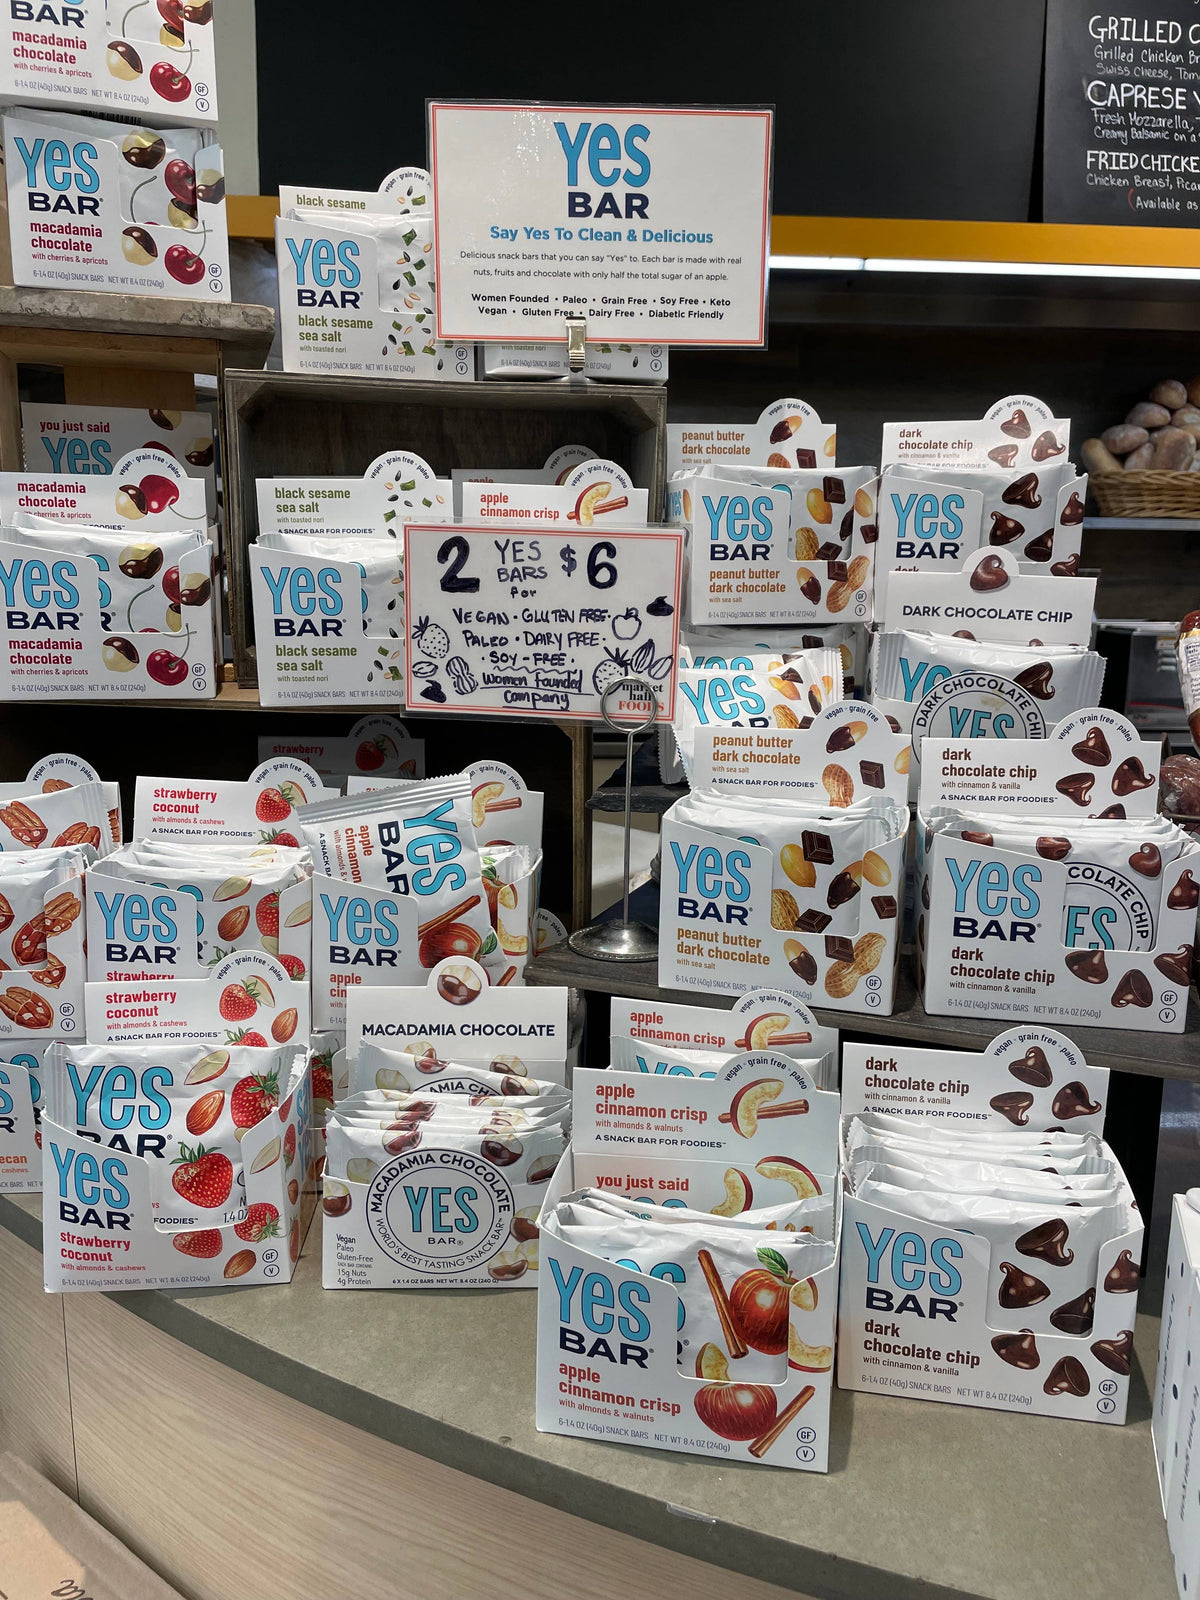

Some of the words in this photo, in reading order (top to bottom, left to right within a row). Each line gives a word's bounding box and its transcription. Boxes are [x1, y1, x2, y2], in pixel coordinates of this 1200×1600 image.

[1088, 15, 1182, 44] GRILLED
[1094, 45, 1134, 63] Grilled
[1140, 48, 1184, 64] Chicken
[1096, 63, 1131, 76] Swiss
[1087, 80, 1187, 110] CAPRESE
[1091, 107, 1125, 126] Fresh
[1093, 125, 1128, 145] Creamy
[1131, 128, 1170, 140] Balsamic
[1174, 133, 1187, 142] on
[554, 122, 651, 188] Yes
[1086, 150, 1139, 171] FRIED
[14, 137, 100, 194] Yes
[1086, 173, 1129, 187] Chicken
[568, 191, 650, 220] BAR
[1187, 201, 1199, 210] as
[30, 222, 103, 239] macadamia
[490, 225, 518, 242] Say
[523, 226, 550, 240] Yes
[554, 227, 573, 241] To
[578, 227, 622, 241] Clean
[626, 229, 637, 242] &
[642, 229, 714, 244] Delicious
[31, 237, 93, 253] chocolate
[32, 252, 46, 261] with
[48, 253, 74, 263] cherries
[75, 256, 81, 264] &
[82, 256, 108, 266] apricots
[285, 238, 361, 288] Yes
[460, 251, 495, 259] Delicious
[498, 252, 520, 260] snack
[522, 252, 539, 260] bars
[541, 252, 557, 261] that
[641, 255, 660, 263] Each
[685, 256, 707, 264] made
[709, 256, 726, 264] with
[727, 256, 742, 264] real
[473, 269, 493, 277] nuts,
[494, 268, 515, 277] fruits
[516, 269, 532, 277] and
[533, 269, 571, 278] chocolate
[573, 270, 590, 278] with
[592, 271, 609, 280] only
[611, 271, 625, 279] half
[641, 272, 660, 280] total
[661, 273, 682, 281] sugar
[684, 272, 692, 280] of
[705, 273, 729, 282] apple.
[471, 293, 506, 303] Women
[509, 294, 549, 303] Founded
[562, 295, 588, 304] Paleo
[601, 296, 625, 304] Grain
[627, 297, 648, 305] Free
[660, 296, 677, 306] Soy
[679, 297, 699, 305] Free
[709, 298, 731, 306] Keto
[478, 306, 507, 316] Vegan
[522, 308, 551, 317] Gluten
[554, 308, 574, 317] Free
[589, 309, 612, 318] Dairy
[615, 309, 635, 317] Free
[648, 309, 685, 318] Diabetic
[688, 310, 724, 320] Friendly
[298, 315, 328, 328] black
[331, 317, 374, 329] sesame
[299, 331, 320, 342] sea
[321, 330, 342, 343] salt
[40, 420, 60, 434] you
[62, 420, 84, 434] just
[87, 420, 111, 433] said
[899, 428, 922, 439] dark
[682, 430, 714, 443] peanut
[716, 430, 745, 442] butter
[682, 444, 703, 455] dark
[706, 444, 751, 456] chocolate
[898, 439, 950, 451] chocolate
[952, 440, 973, 452] chip
[17, 481, 87, 494] macadamia
[275, 487, 305, 499] black
[308, 489, 350, 499] sesame
[18, 496, 77, 508] chocolate
[480, 492, 508, 505] apple
[276, 503, 297, 513] sea
[299, 501, 320, 513] salt
[480, 506, 531, 519] cinnamon
[533, 507, 560, 520] crisp
[494, 538, 542, 564] YES
[436, 534, 481, 594] 2
[496, 567, 549, 583] BARS
[510, 585, 538, 599] for
[452, 607, 510, 626] VEGAN
[521, 608, 575, 624] GLUTEN
[579, 608, 609, 624] FREE
[902, 605, 941, 617] DARK
[944, 606, 1033, 622] CHOCOLATE
[1037, 610, 1073, 623] CHIP
[462, 629, 509, 648] PALEO
[523, 631, 562, 651] DAIRY
[567, 632, 600, 648] FREE
[713, 736, 753, 748] peanut
[756, 735, 793, 749] butter
[712, 750, 739, 763] dark
[742, 751, 801, 765] chocolate
[942, 748, 972, 760] dark
[941, 763, 1006, 777] chocolate
[1009, 765, 1037, 781] chip
[957, 781, 990, 789] cinnamon
[998, 782, 1021, 790] vanilla
[106, 990, 177, 1004] strawberry
[106, 1006, 159, 1019] coconut
[106, 1022, 121, 1030] with
[122, 1021, 151, 1029] almonds
[152, 1021, 158, 1029] &
[159, 1020, 188, 1028] cashews
[361, 1023, 457, 1036] MACADAMIA
[459, 1024, 556, 1037] CHOCOLATE
[865, 1056, 898, 1072] dark
[595, 1083, 635, 1101] apple
[864, 1074, 935, 1092] chocolate
[938, 1080, 970, 1096] chip
[864, 1092, 880, 1101] with
[881, 1092, 918, 1103] cinnamon
[919, 1095, 925, 1103] &
[927, 1096, 951, 1105] vanilla
[595, 1100, 667, 1119] cinnamon
[670, 1105, 708, 1124] crisp
[603, 1135, 635, 1143] SNACK
[659, 1138, 678, 1146] FOR
[50, 1142, 130, 1209] Yes
[402, 1185, 480, 1234] YES
[60, 1232, 131, 1251] strawberry
[336, 1233, 356, 1244] Vegan
[60, 1247, 113, 1262] coconut
[336, 1243, 355, 1252] Paleo
[336, 1252, 374, 1262] Gluten-Free
[548, 1257, 651, 1343] Yes
[559, 1362, 601, 1384] apple
[559, 1381, 635, 1408] cinnamon
[640, 1397, 681, 1416] crisp
